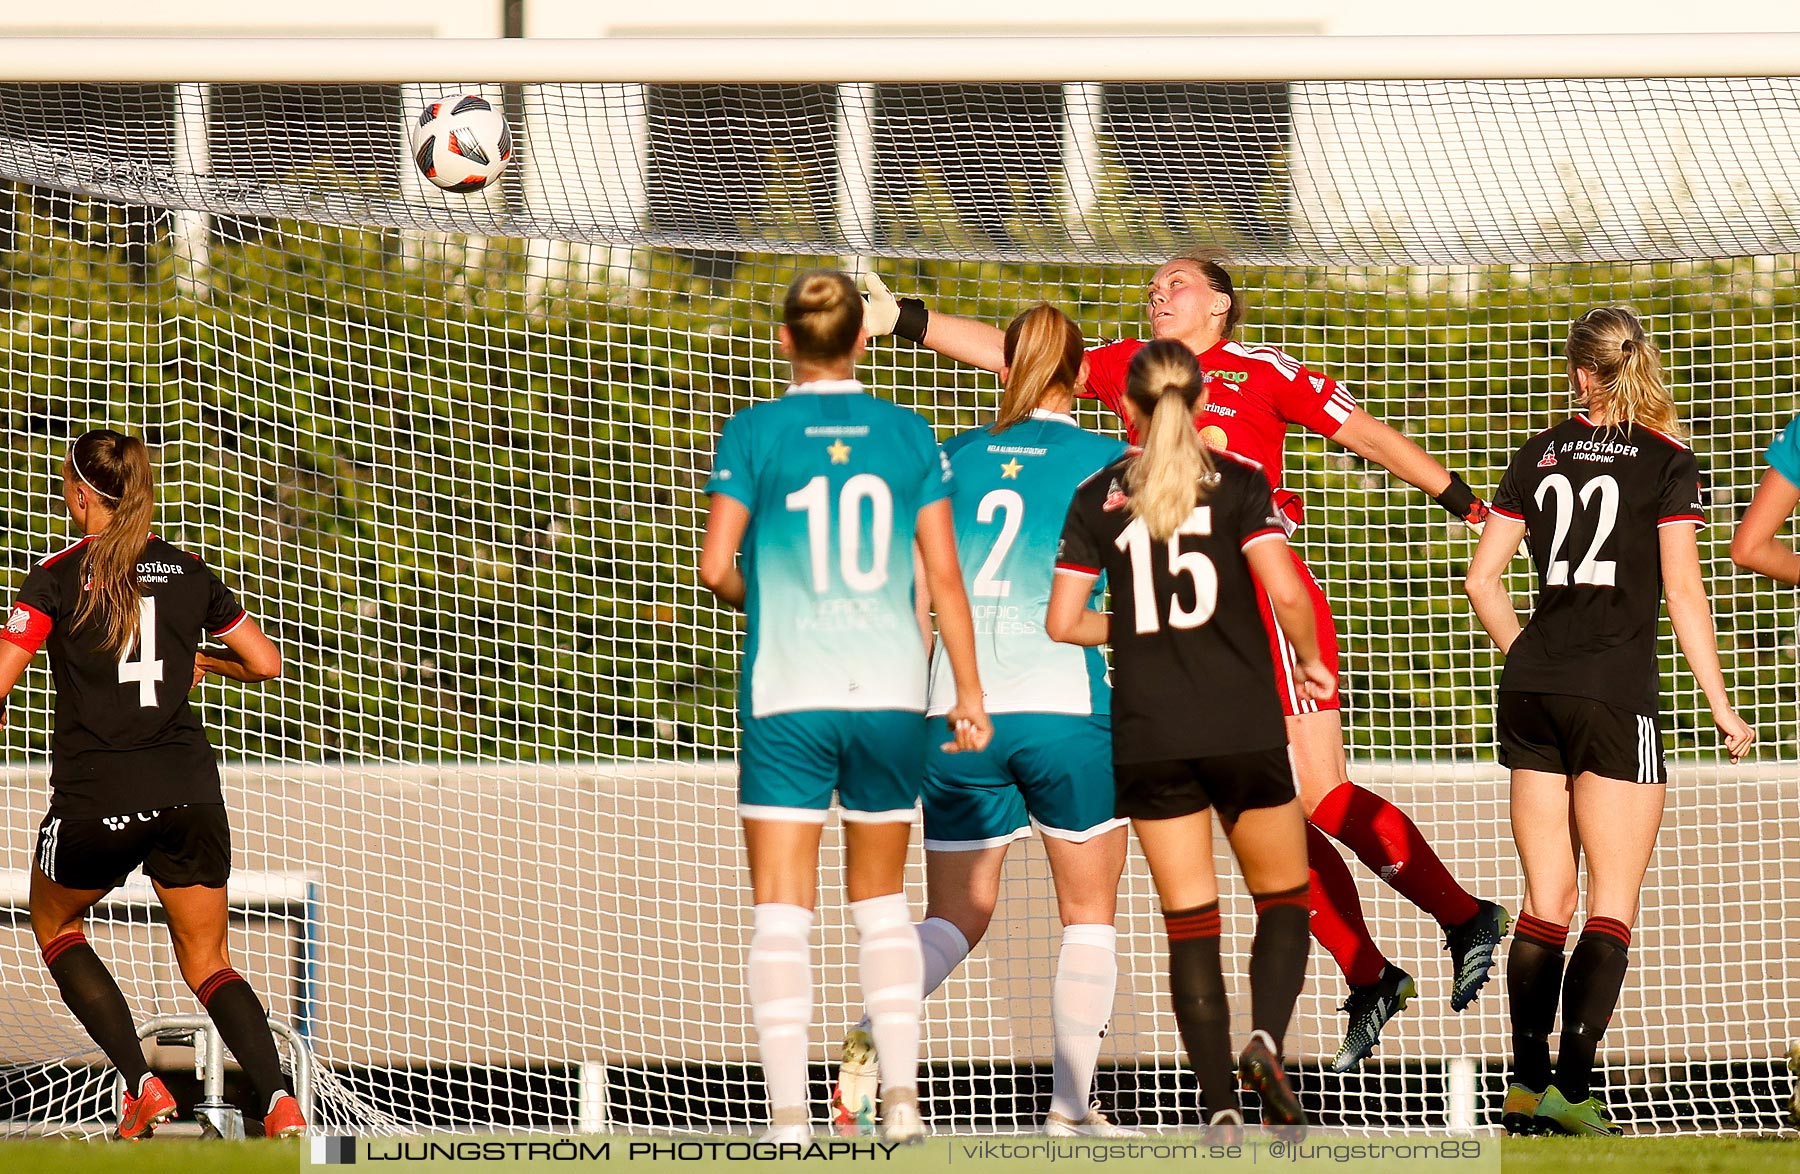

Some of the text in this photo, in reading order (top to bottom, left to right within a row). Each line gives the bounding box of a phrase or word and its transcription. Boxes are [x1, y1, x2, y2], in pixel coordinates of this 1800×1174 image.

[1560, 440, 1639, 457] AB BOSTÄDER
[1572, 453, 1615, 463] LIDKÖPING
[136, 561, 184, 575] OSTÄDER
[786, 473, 893, 593] 10
[973, 489, 1024, 598] 2
[1114, 506, 1219, 635] 15
[1534, 473, 1620, 586] 22
[118, 596, 164, 708] 4
